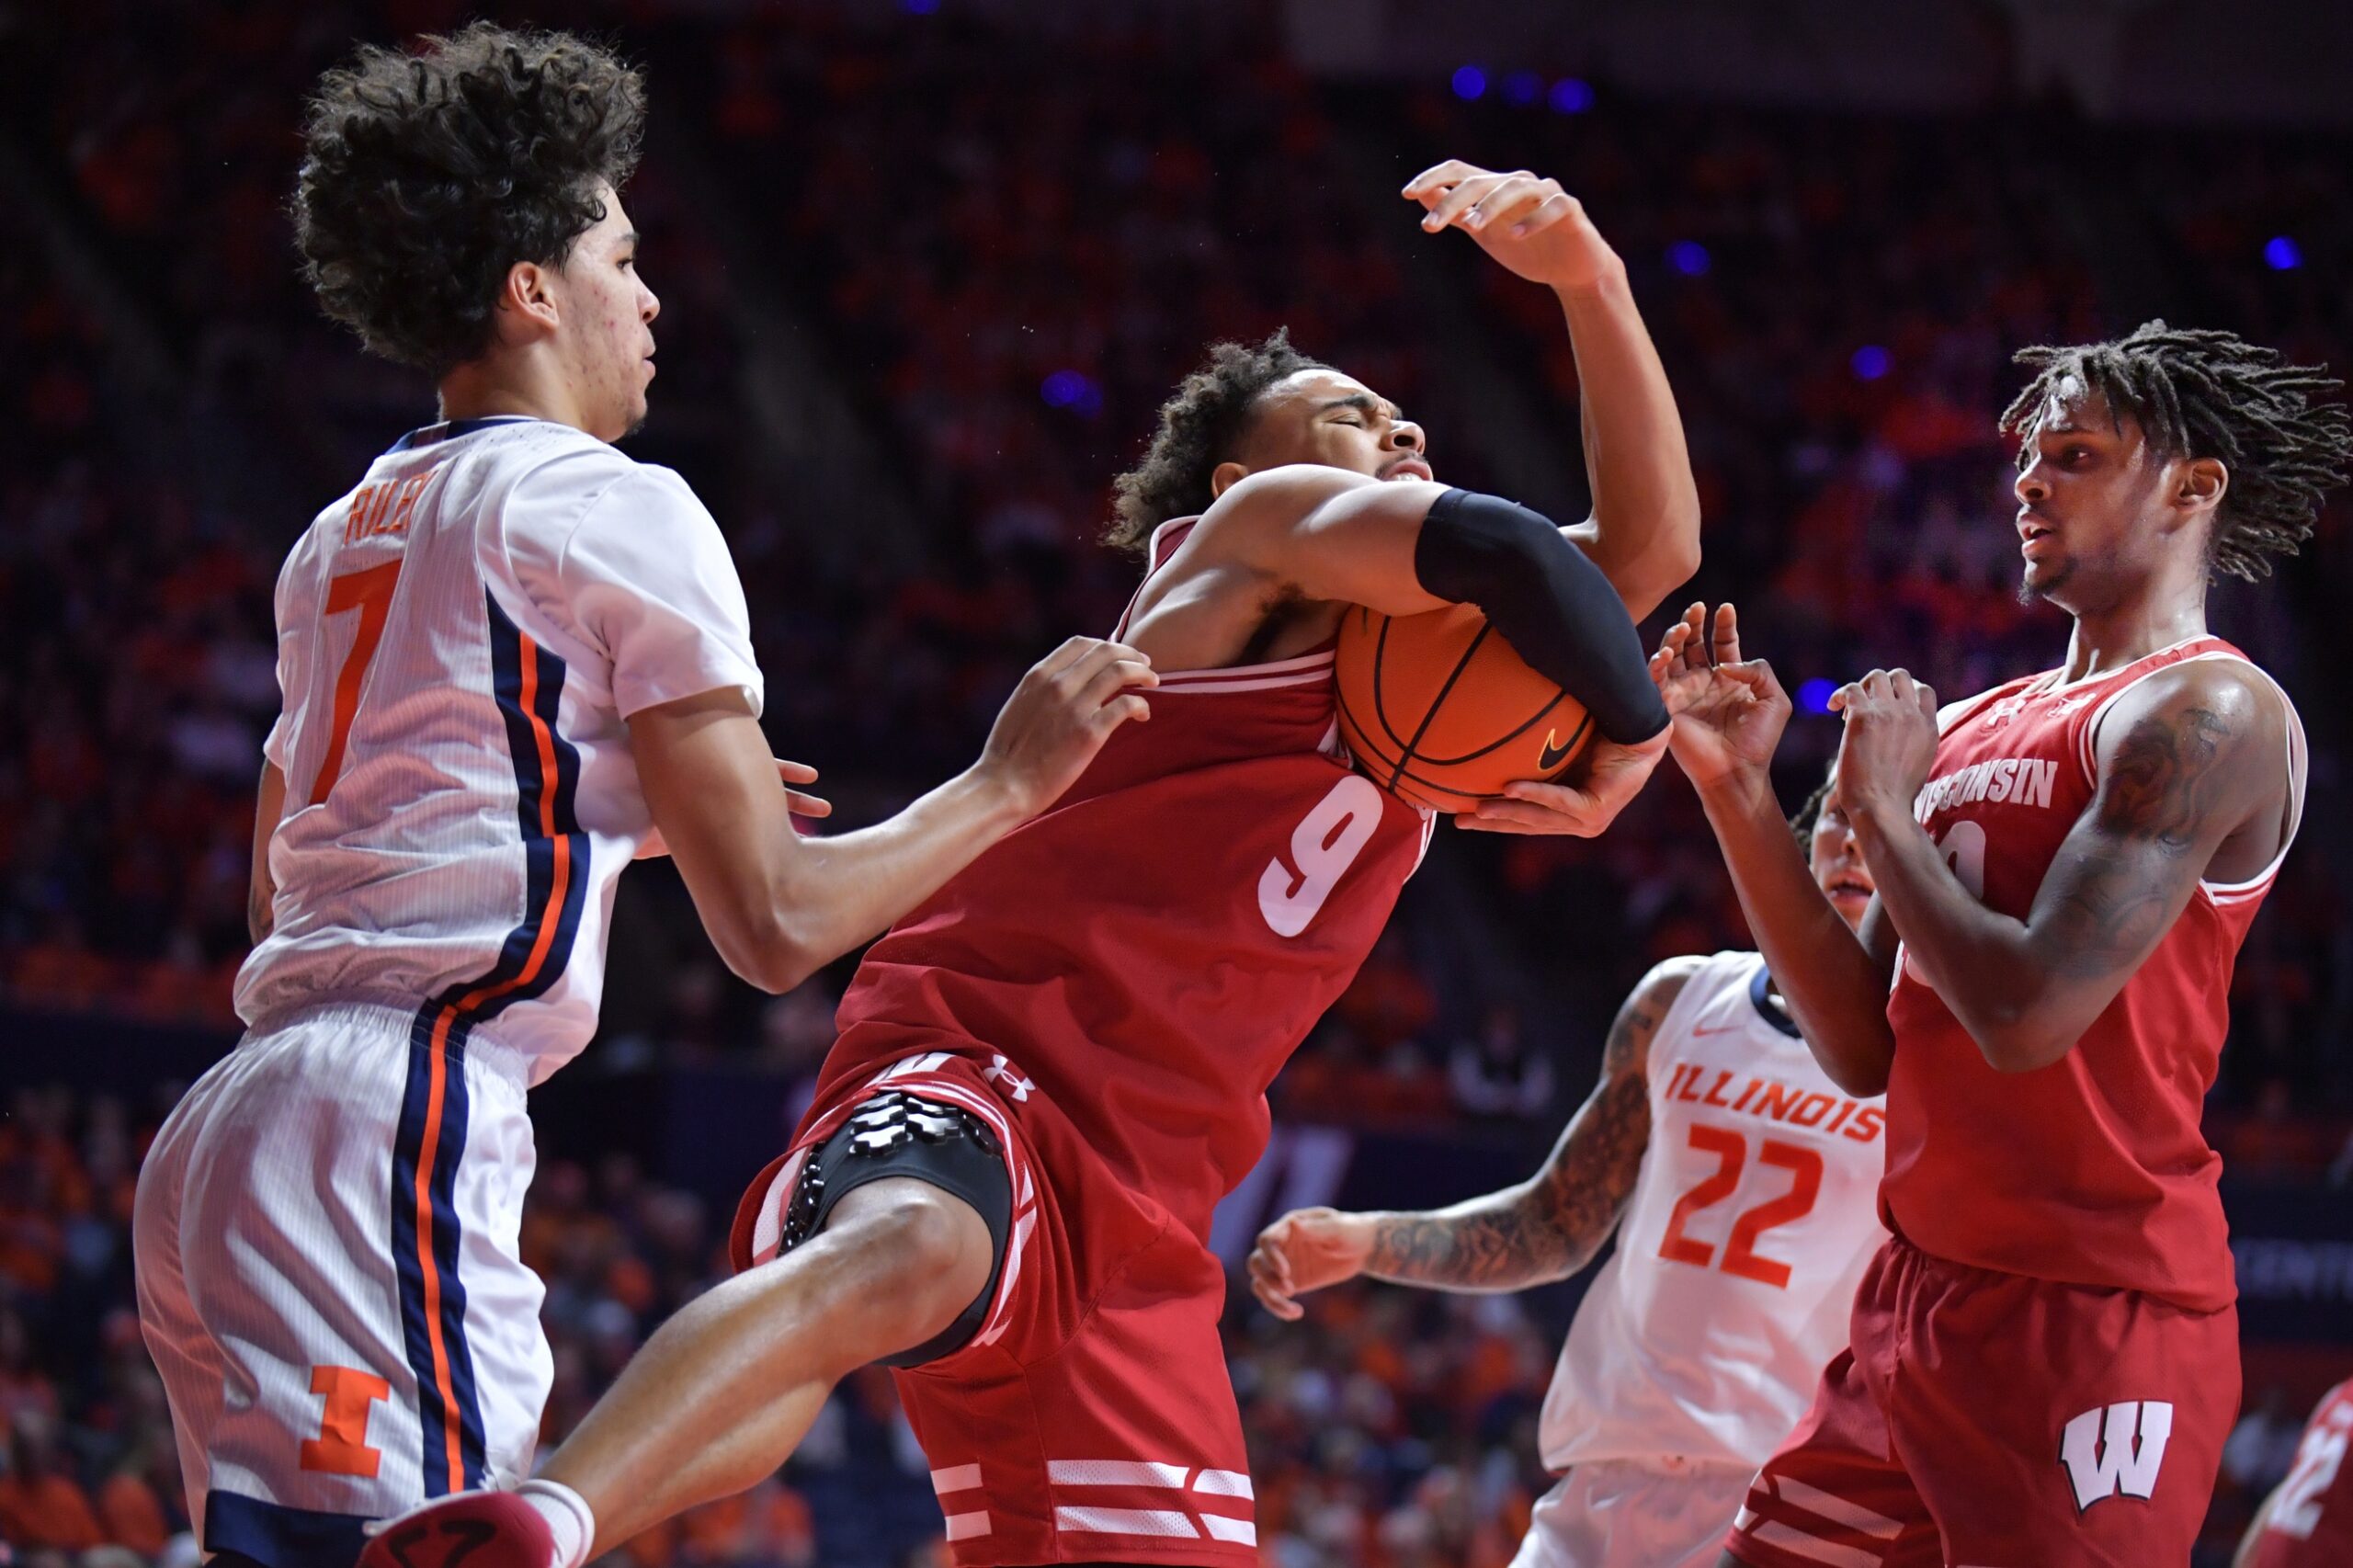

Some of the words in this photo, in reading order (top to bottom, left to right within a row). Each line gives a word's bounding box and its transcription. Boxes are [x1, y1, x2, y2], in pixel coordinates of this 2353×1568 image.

[308, 558, 403, 806] 7
[1257, 774, 1383, 937] 9
[1665, 1062, 1886, 1143] ILLINOIS
[1658, 1122, 1824, 1291] 22
[300, 1365, 390, 1479] I
[2059, 1400, 2174, 1515] W
